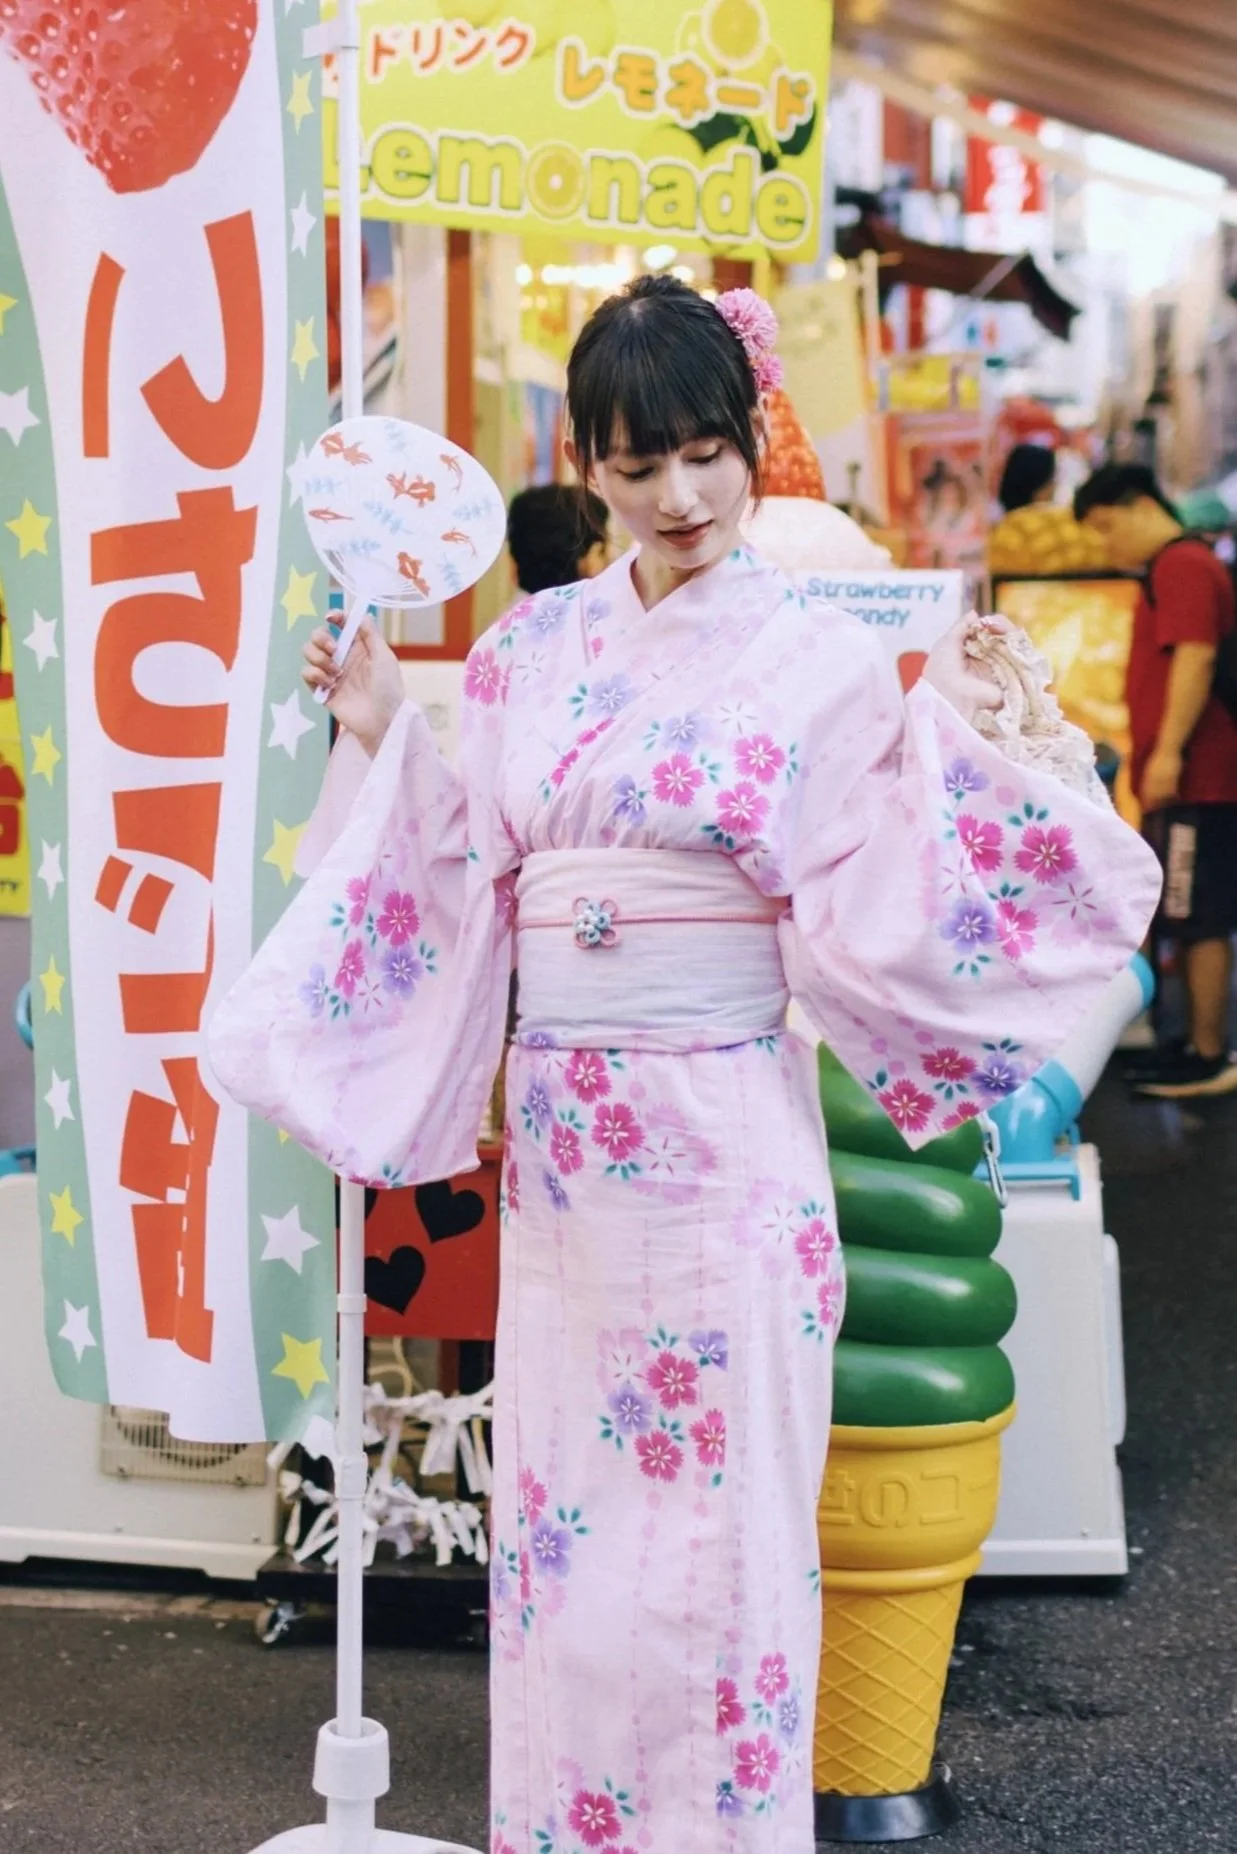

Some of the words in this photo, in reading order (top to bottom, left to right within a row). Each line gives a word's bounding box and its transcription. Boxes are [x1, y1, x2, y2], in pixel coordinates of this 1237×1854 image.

[322, 25, 531, 81] ドリンク
[562, 45, 809, 132] レモネード
[807, 576, 945, 603] Strawberry
[843, 606, 910, 628] andy
